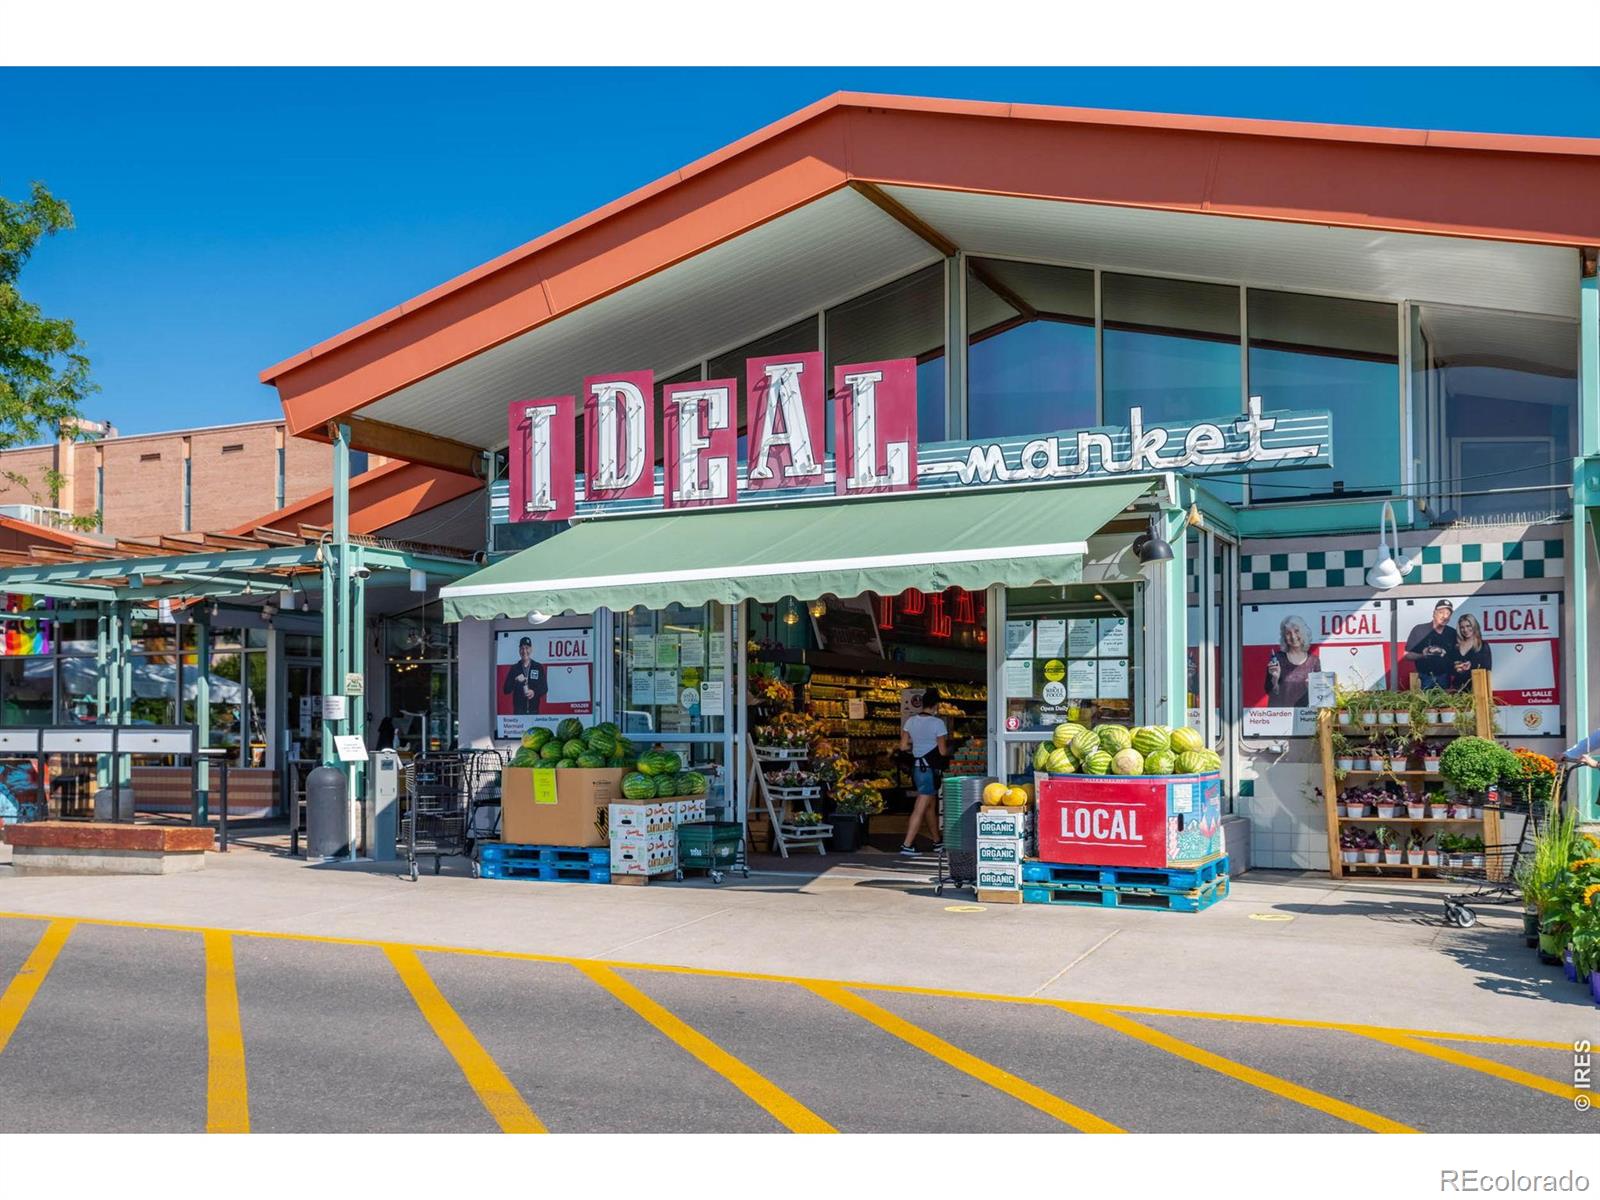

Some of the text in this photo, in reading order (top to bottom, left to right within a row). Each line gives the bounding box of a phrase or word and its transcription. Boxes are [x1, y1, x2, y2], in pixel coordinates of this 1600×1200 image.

[518, 361, 1322, 513] IDEAL market
[1320, 614, 1382, 636] LOCAL
[1483, 608, 1550, 632] LOCAL
[548, 640, 588, 658] LOCAL
[1249, 710, 1292, 718] WishGarden
[981, 823, 1014, 832] ORGANIC
[1061, 807, 1143, 841] LOCAL
[981, 849, 1014, 858] ORGANIC
[981, 874, 1014, 884] ORGANIC
